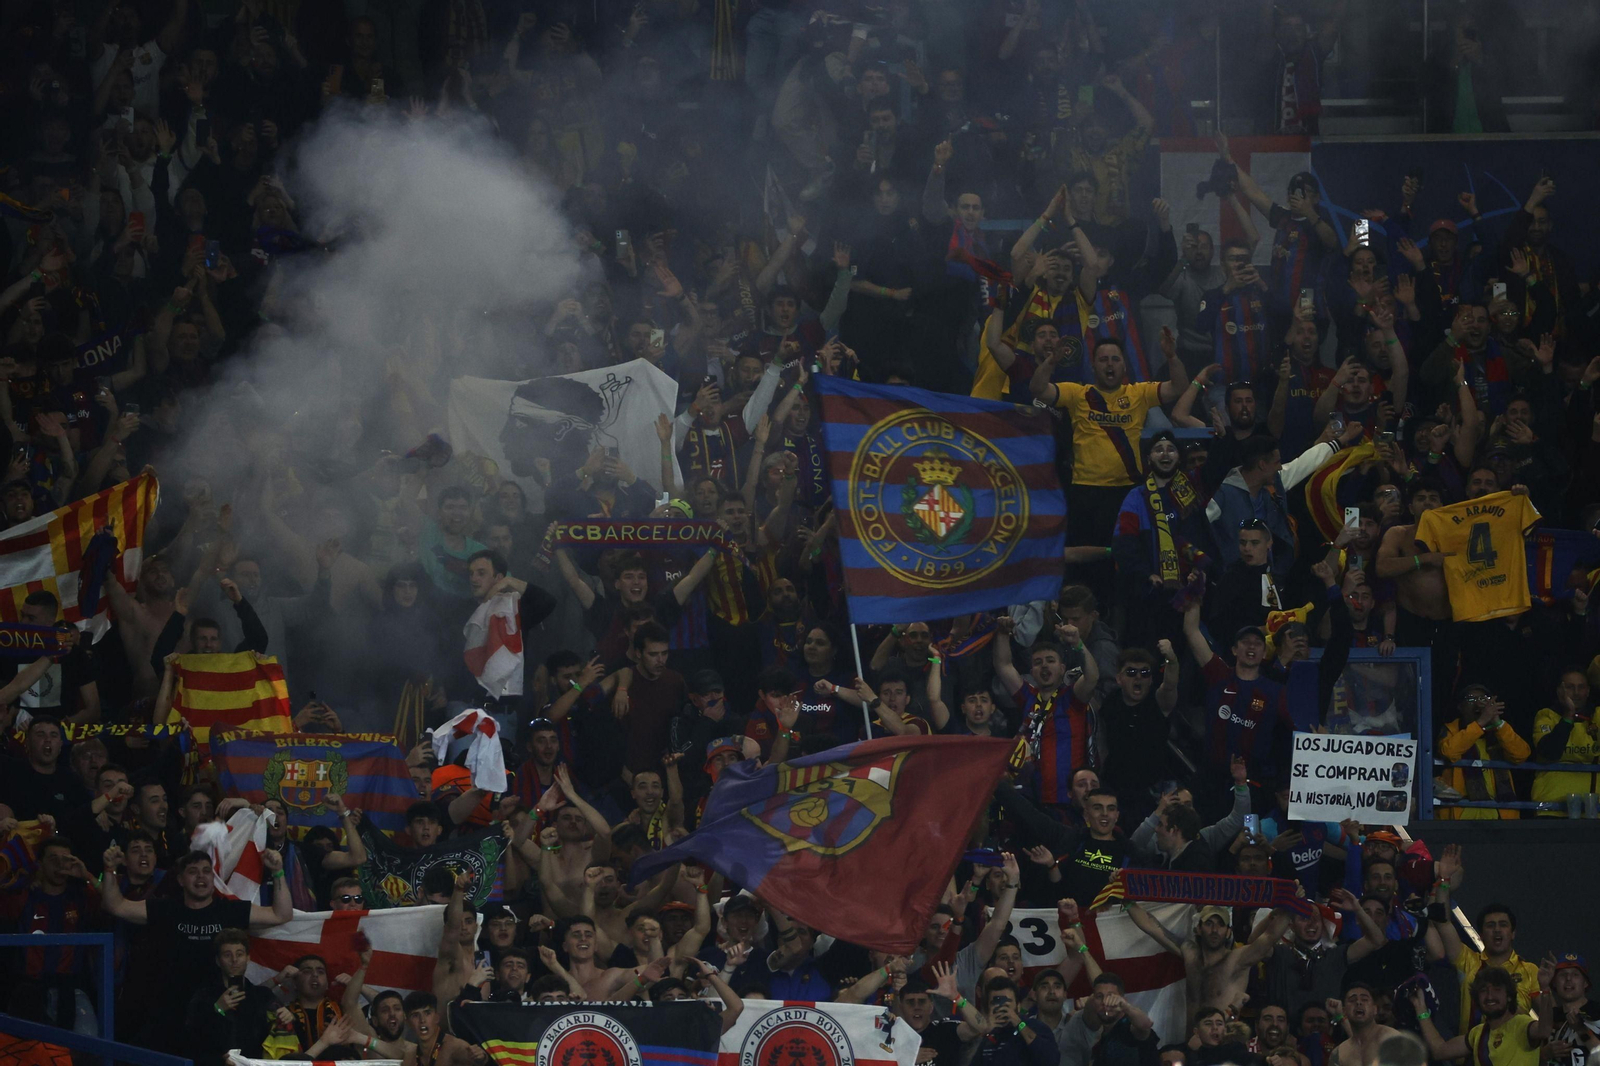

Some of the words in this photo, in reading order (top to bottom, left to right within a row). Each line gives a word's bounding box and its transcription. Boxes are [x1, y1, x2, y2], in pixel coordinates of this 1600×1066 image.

[1088, 411, 1133, 423] Rakuten
[859, 435, 903, 554] FOOT-BALL
[901, 421, 955, 441] CLUB
[961, 434, 1017, 556] BARCELONA
[1452, 514, 1465, 525] R.
[1466, 504, 1505, 518] ARAUJO
[1467, 522, 1498, 569] 4
[914, 557, 965, 577] 1899
[0, 630, 46, 650] ONA
[801, 703, 832, 713] Spotify
[1230, 713, 1257, 730] Spotify
[1295, 738, 1320, 751] LOS
[1322, 739, 1413, 758] JUGADORES
[1565, 744, 1590, 755] nicef
[1292, 764, 1309, 778] SE
[1315, 765, 1390, 782] COMPRAN
[1289, 791, 1303, 804] LA
[1291, 848, 1323, 864] beko
[1127, 873, 1274, 902] ANTIMADRIDISTA
[545, 1014, 596, 1042] BACARDI
[604, 1018, 631, 1045] BOYS
[754, 1010, 808, 1039] BACARDI
[816, 1013, 844, 1045] BOYS
